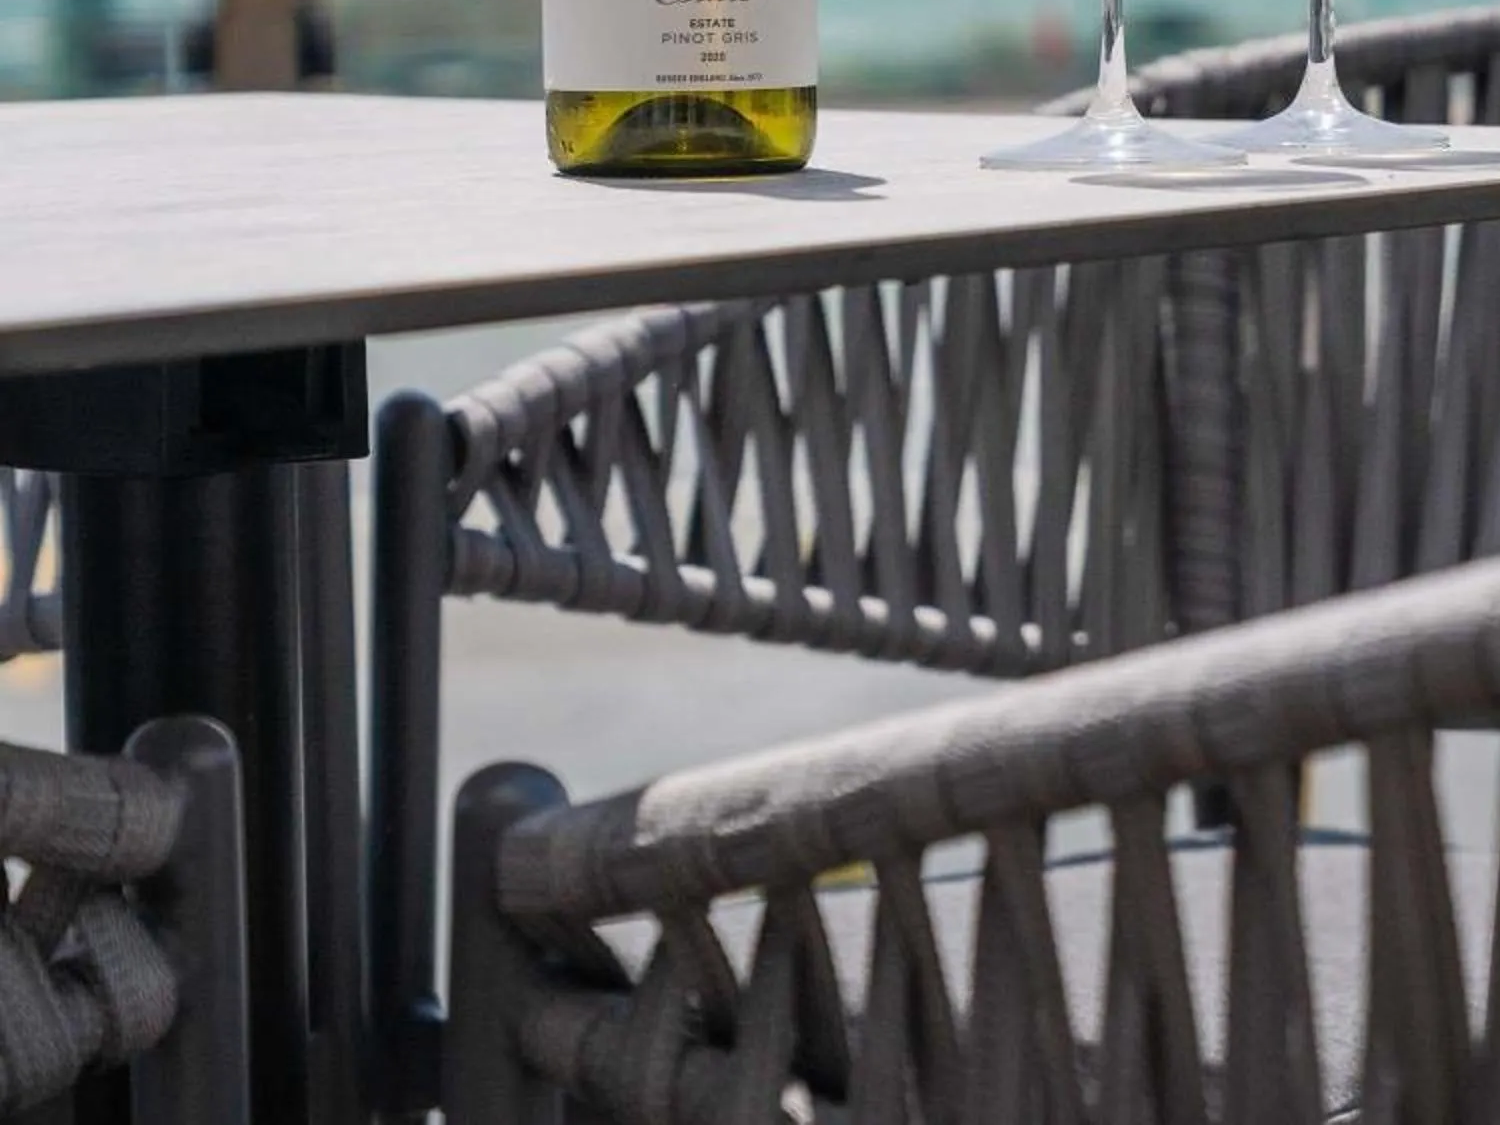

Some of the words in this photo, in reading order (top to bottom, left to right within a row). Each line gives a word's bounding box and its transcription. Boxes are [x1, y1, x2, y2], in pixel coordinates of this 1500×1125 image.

[689, 18, 736, 29] ESTATE
[661, 31, 715, 44] PINOT
[721, 30, 760, 44] GRIS
